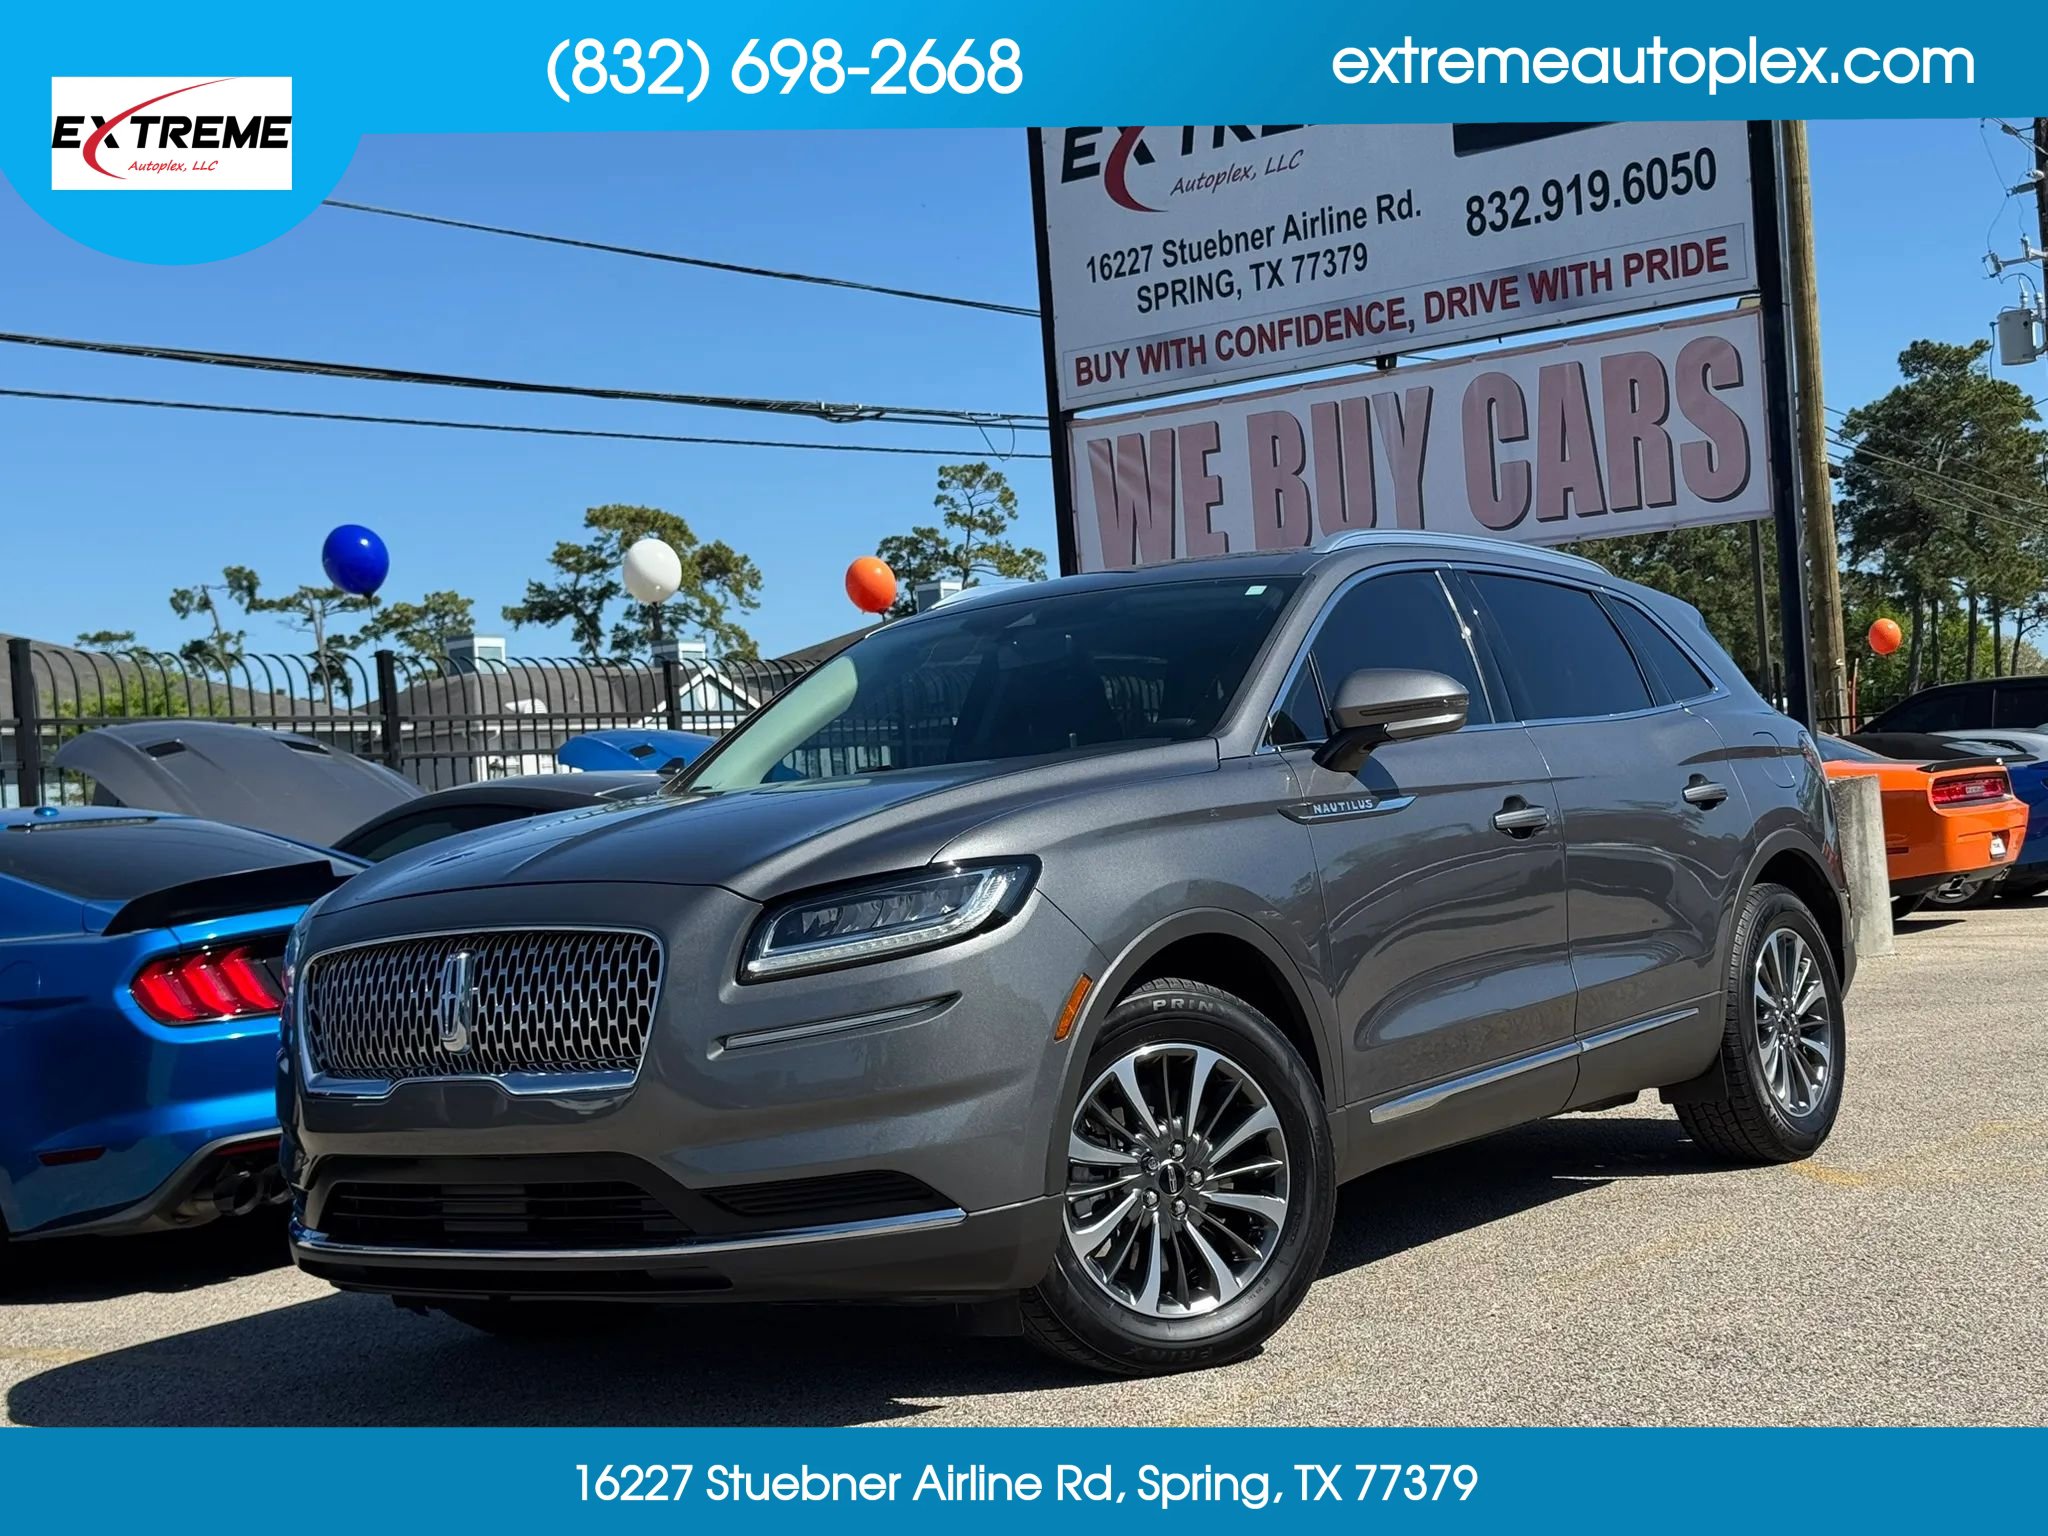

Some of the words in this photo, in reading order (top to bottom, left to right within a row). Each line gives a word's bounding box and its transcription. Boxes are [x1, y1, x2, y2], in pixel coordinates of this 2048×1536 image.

[1170, 163, 1257, 196] Autoplex,
[1264, 149, 1304, 176] LLC
[1465, 147, 1717, 237] 832.919.6050
[1086, 244, 1153, 283] 16227
[1162, 225, 1275, 268] Stuebner
[1282, 204, 1368, 244] Airline
[1376, 189, 1422, 225] Rd.
[1137, 269, 1242, 314] SPRING,
[1249, 259, 1284, 292] TX
[1291, 242, 1369, 284] 77379
[1075, 348, 1130, 387] BUY
[1136, 334, 1207, 375] WITH
[1215, 297, 1415, 361] CONFIDENCE,
[1424, 275, 1519, 324] DRIVE
[1527, 258, 1613, 304] WITH
[1623, 236, 1729, 287] PRIDE
[1087, 420, 1229, 569] WE
[1246, 385, 1434, 551] BUY
[1462, 336, 1751, 532] CARS
[1312, 799, 1374, 815] NAUTILUS
